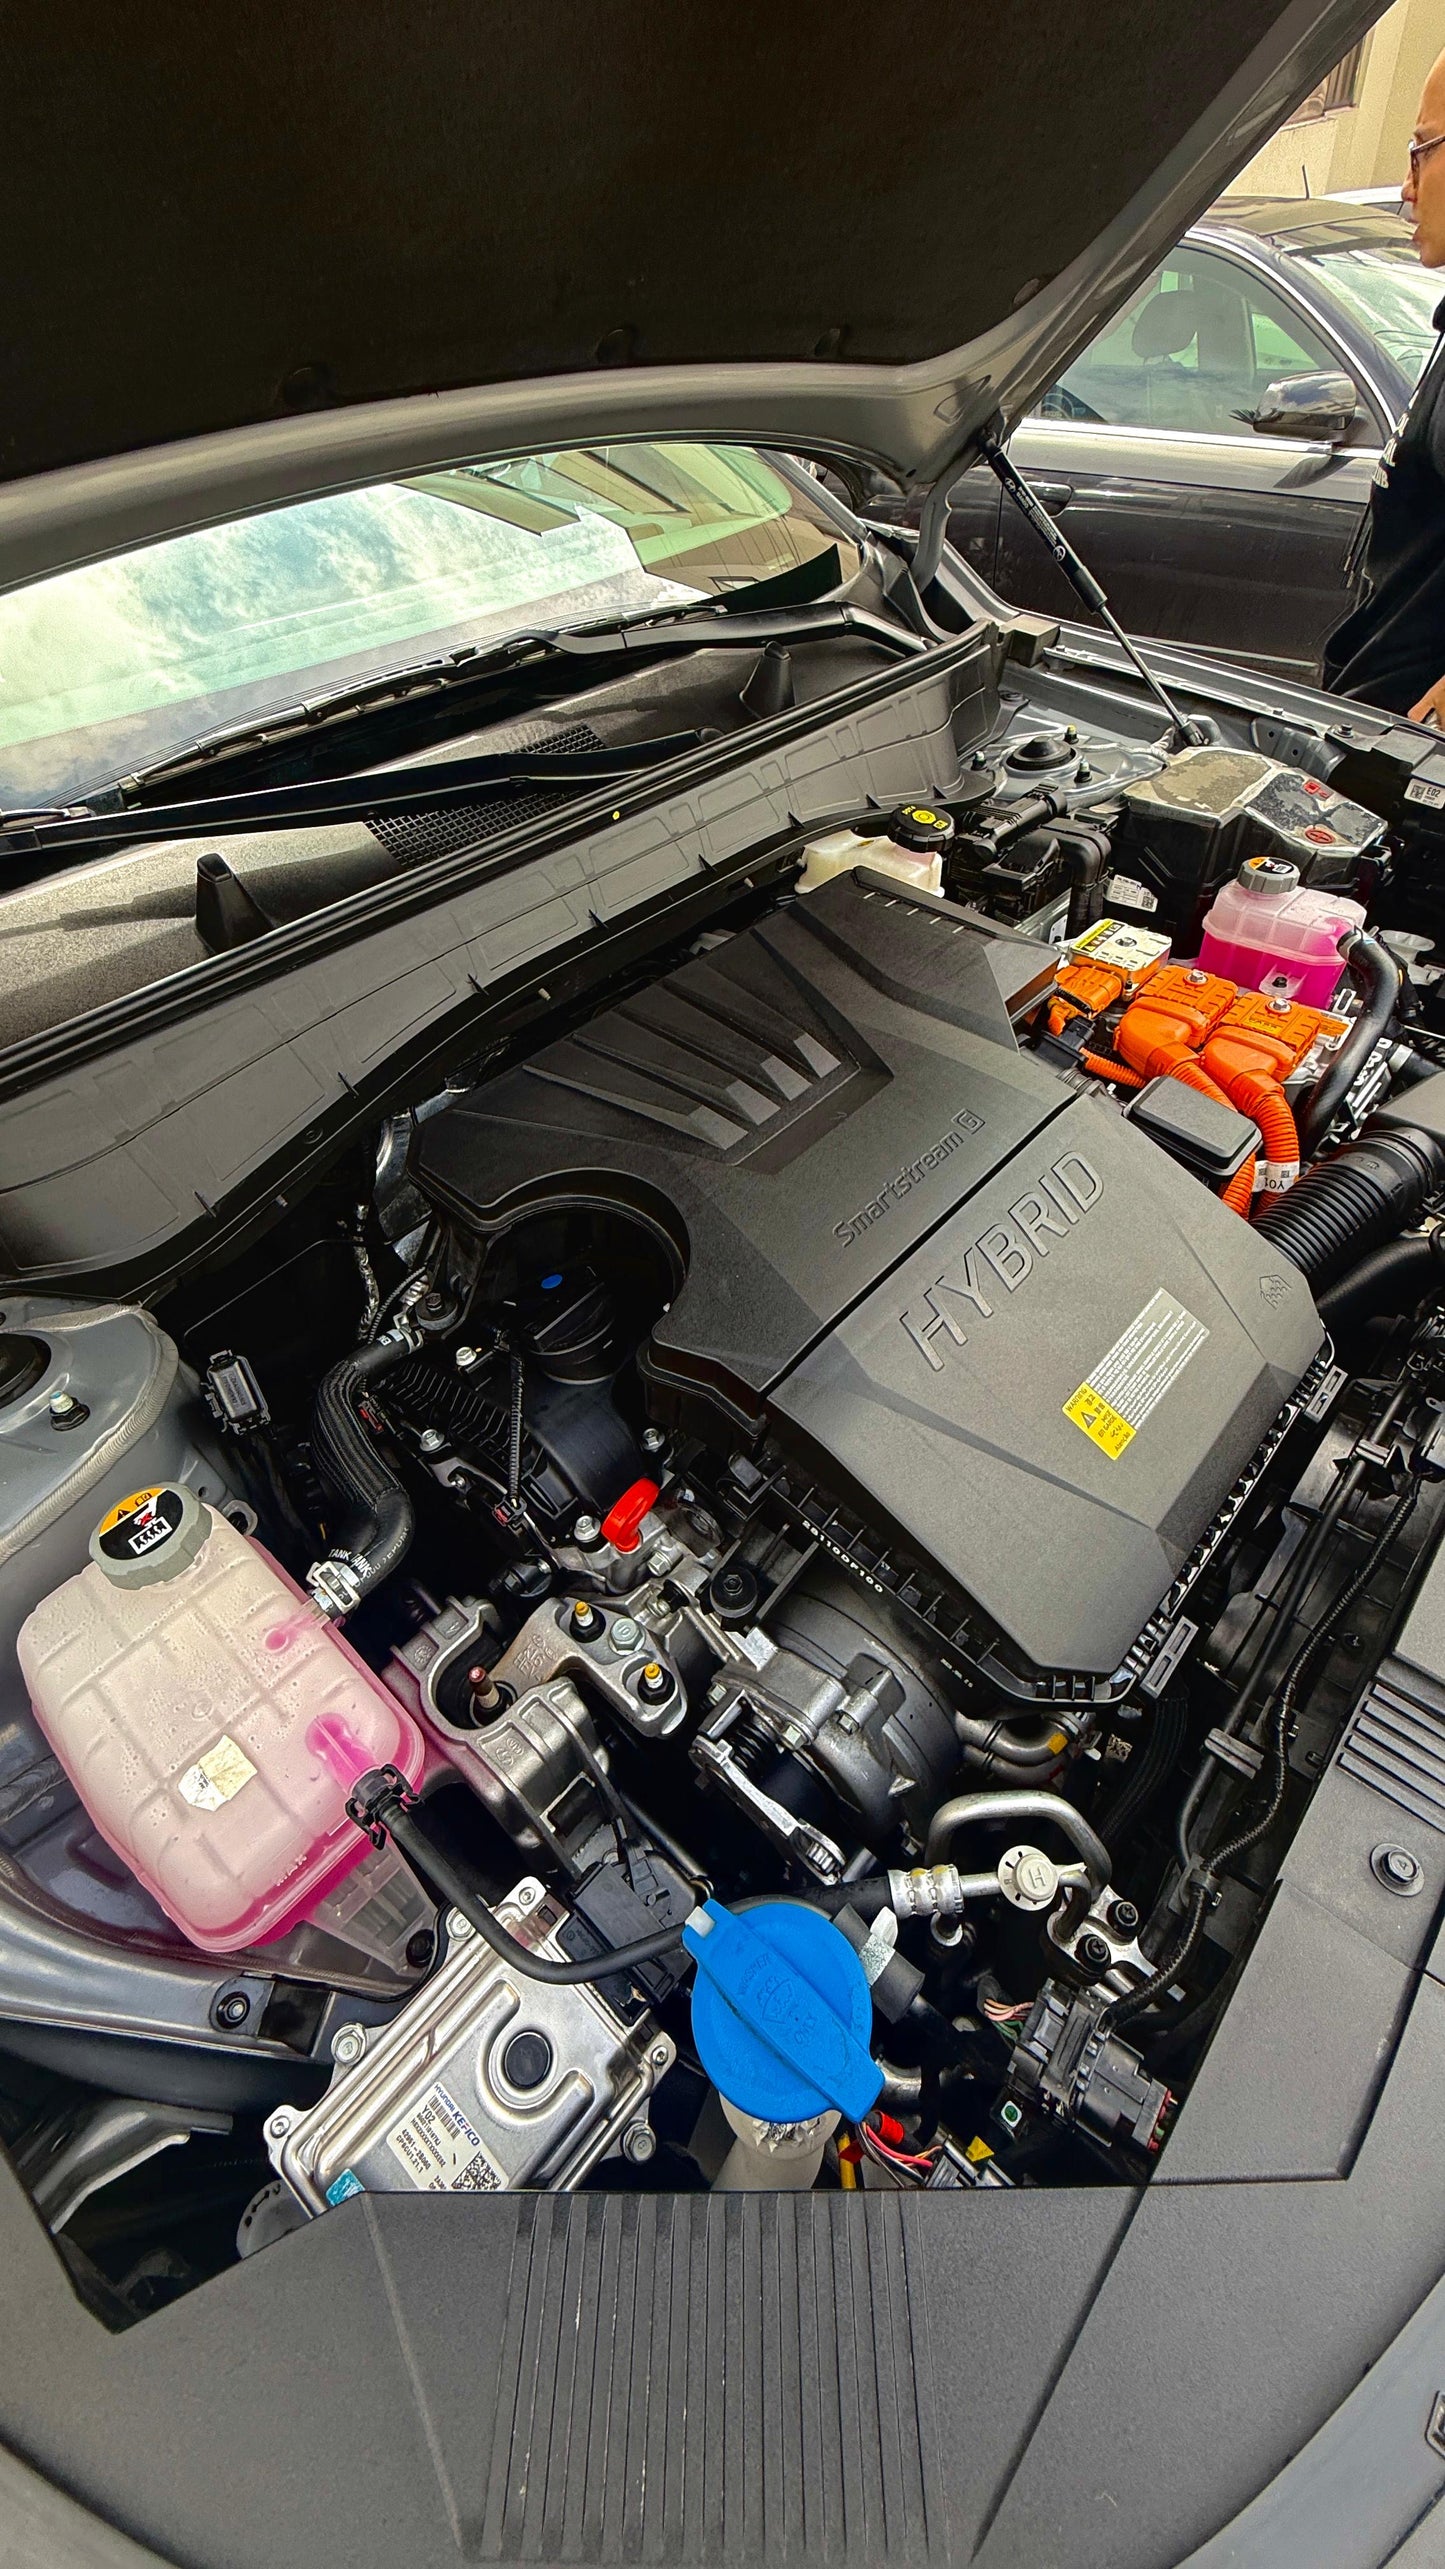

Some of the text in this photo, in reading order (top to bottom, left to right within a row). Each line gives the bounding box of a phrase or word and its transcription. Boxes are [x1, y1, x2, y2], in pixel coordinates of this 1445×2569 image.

[832, 1130, 965, 1248] Smartstream
[899, 1150, 1104, 1372] HYBRID
[1065, 1388, 1088, 1412] WARNING
[328, 1548, 352, 1561] TANK
[350, 1553, 373, 1579] TANK
[420, 2104, 436, 2124] Y02
[434, 2084, 481, 2147] HYUNDAI KEFICO
